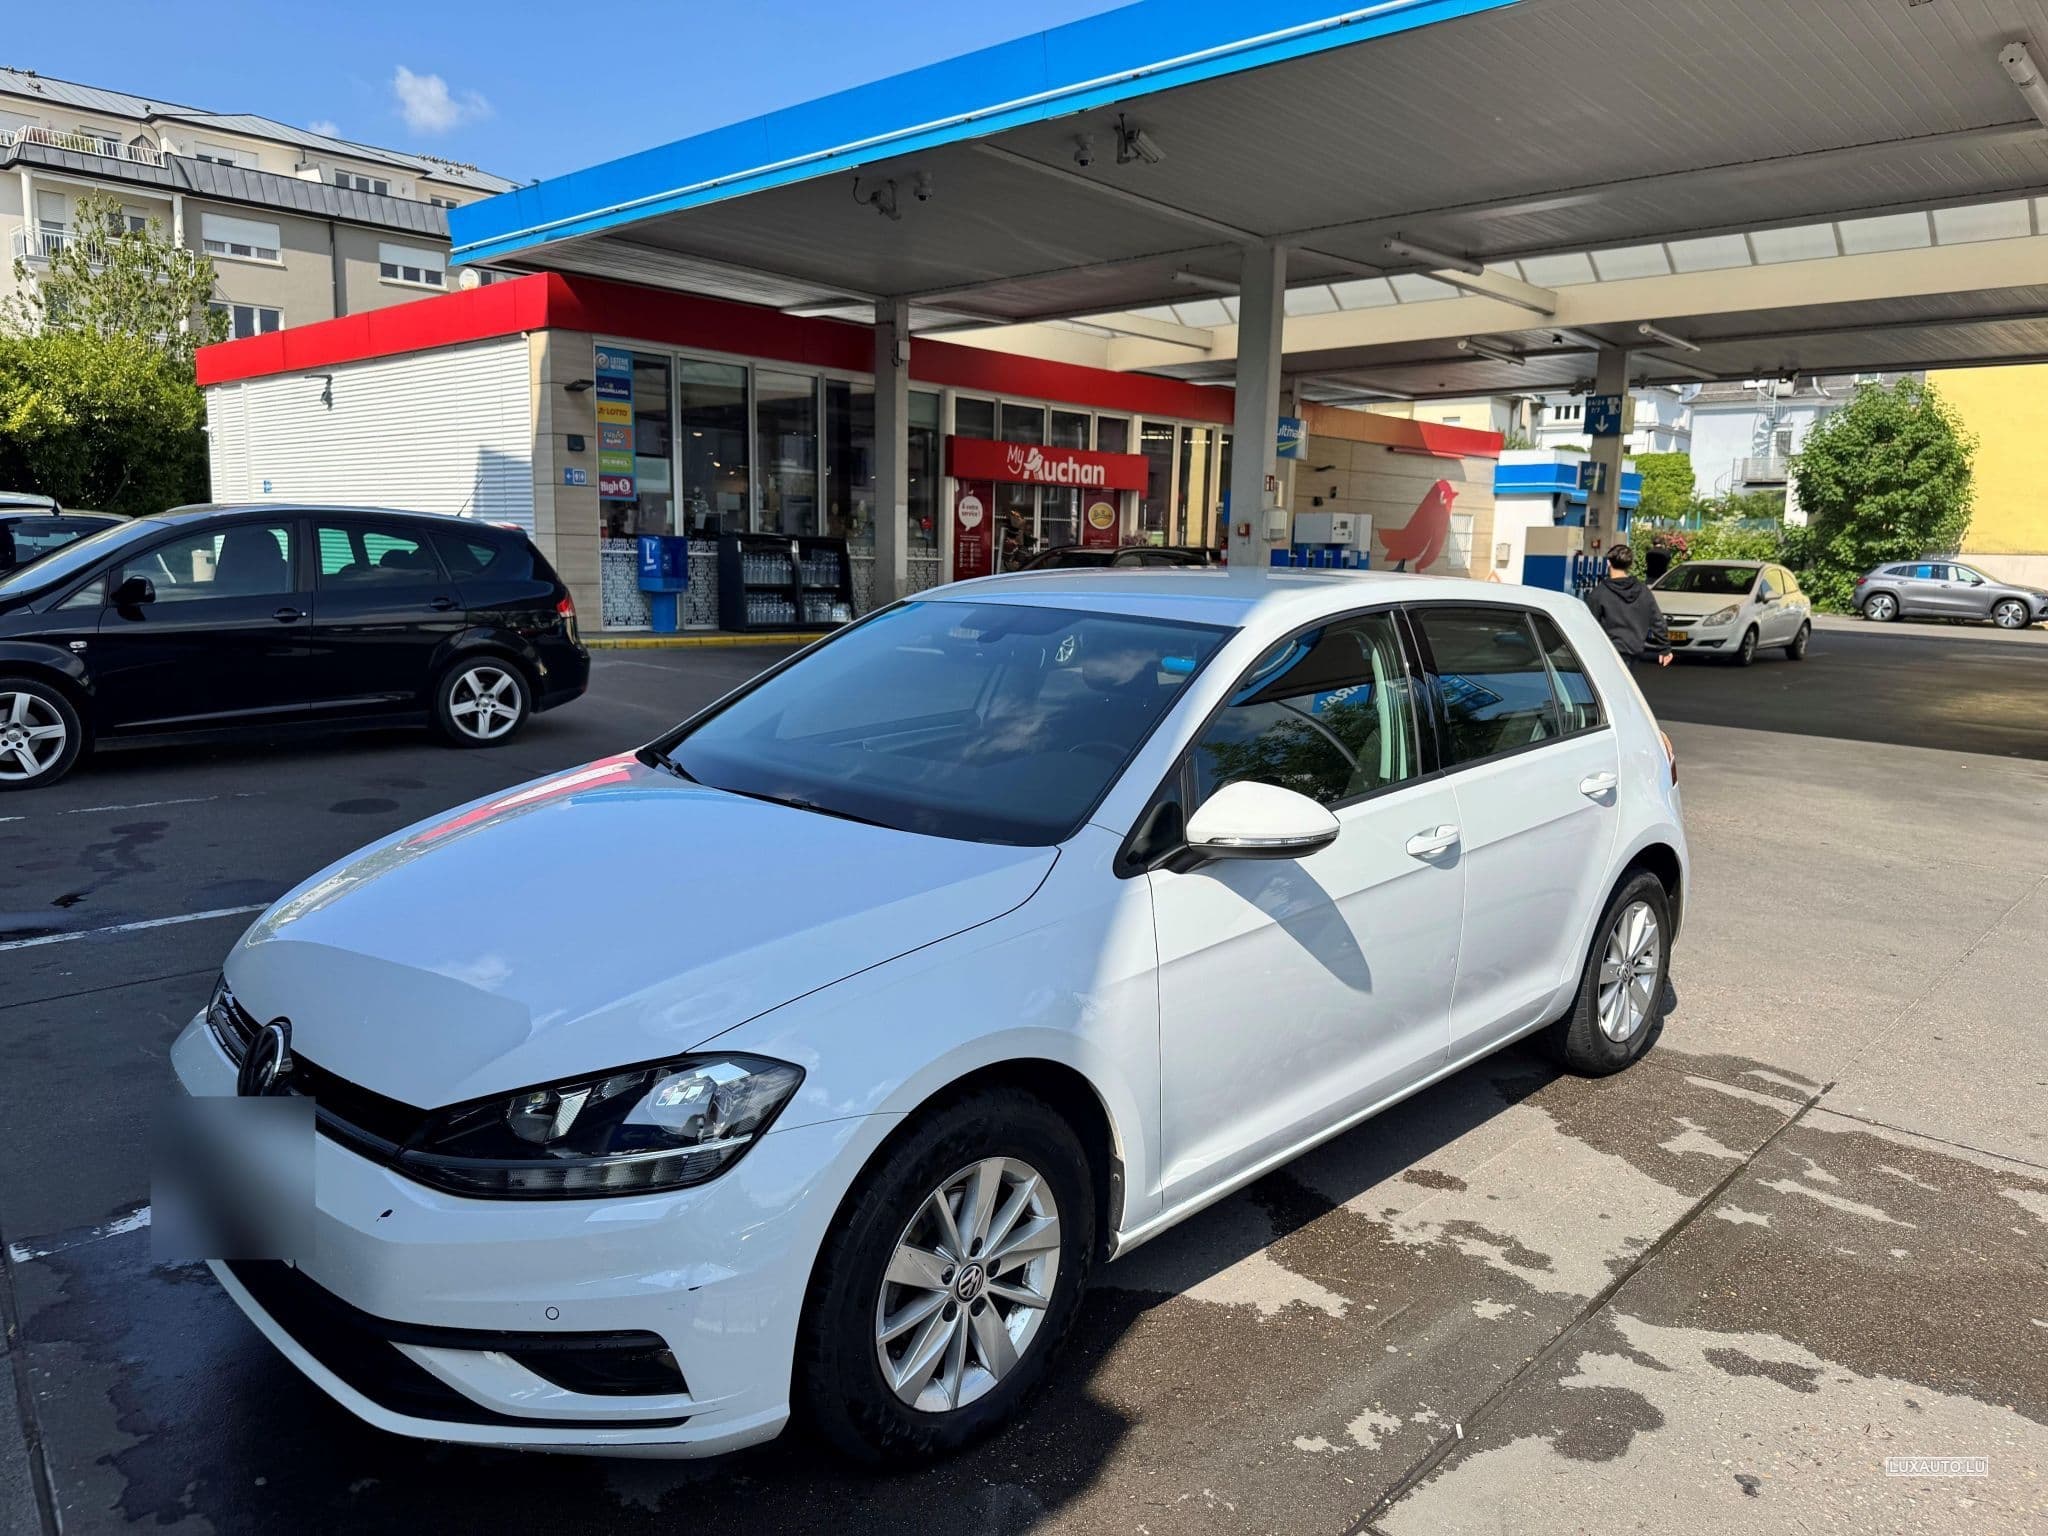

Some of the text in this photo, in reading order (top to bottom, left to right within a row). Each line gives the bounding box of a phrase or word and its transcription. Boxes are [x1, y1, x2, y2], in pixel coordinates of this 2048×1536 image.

[606, 407, 628, 417] LOTTO
[1006, 444, 1105, 485] My Auchan
[600, 480, 619, 494] High
